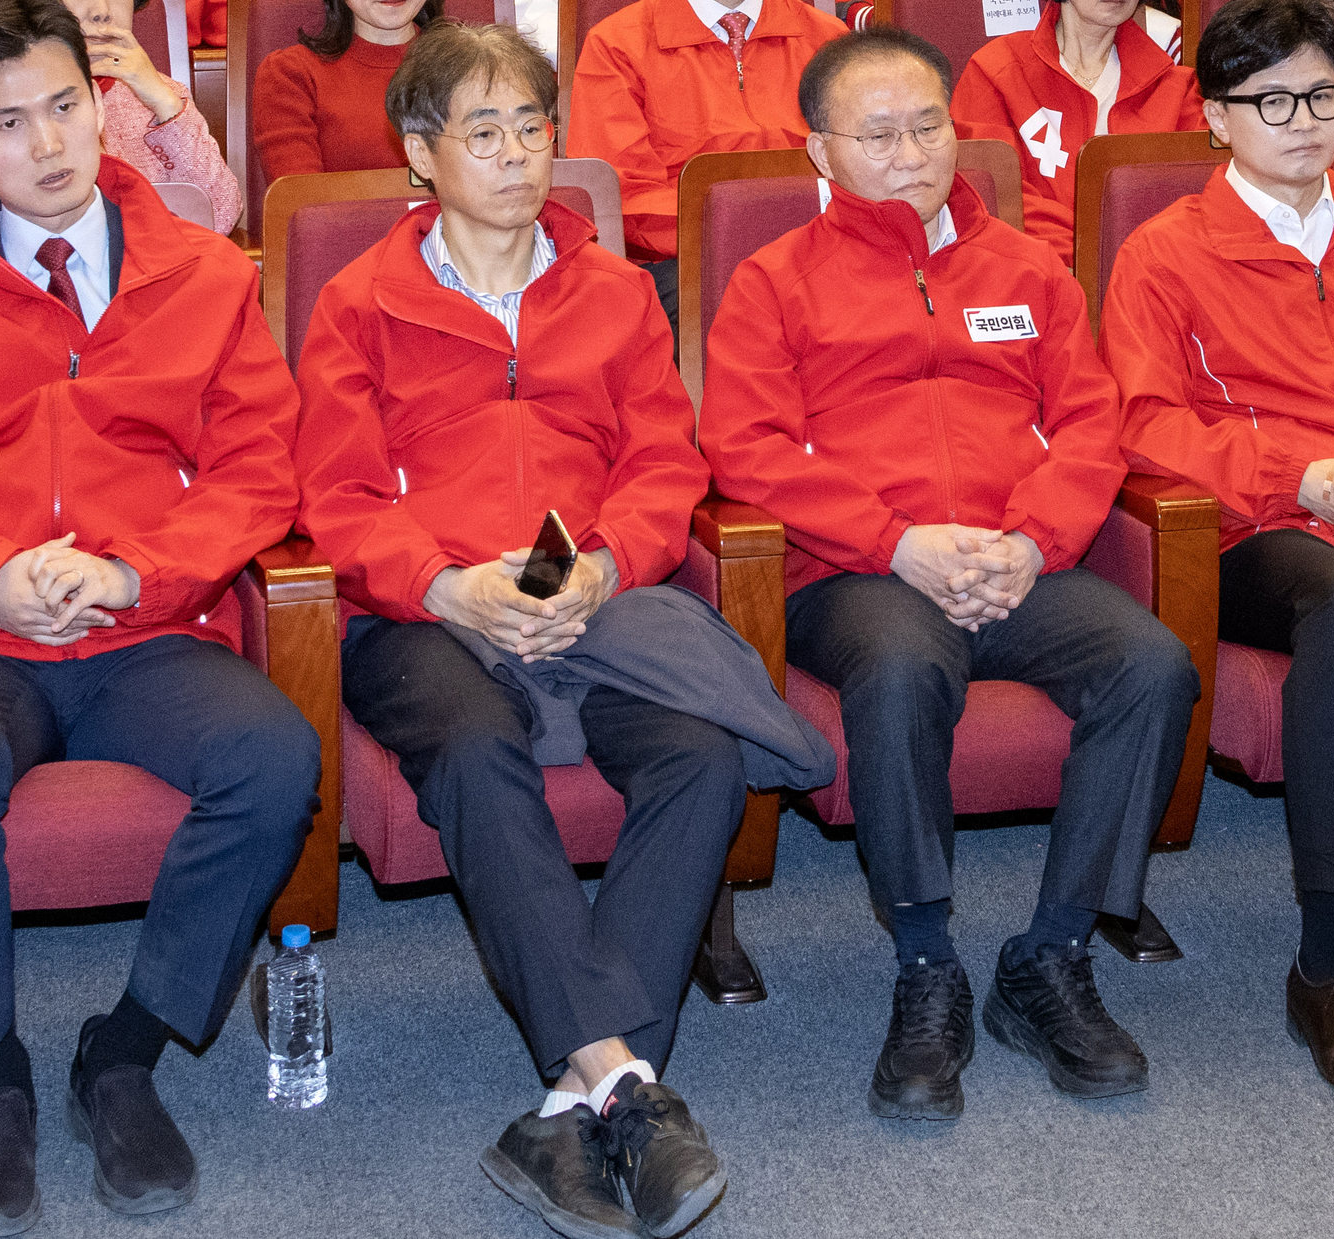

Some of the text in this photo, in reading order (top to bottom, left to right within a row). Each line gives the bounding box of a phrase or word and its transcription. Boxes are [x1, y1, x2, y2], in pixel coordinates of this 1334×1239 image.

[985, 6, 1036, 19] 비례대표 후보자
[1019, 107, 1069, 178] 4
[976, 315, 1027, 333] 국민의힘
